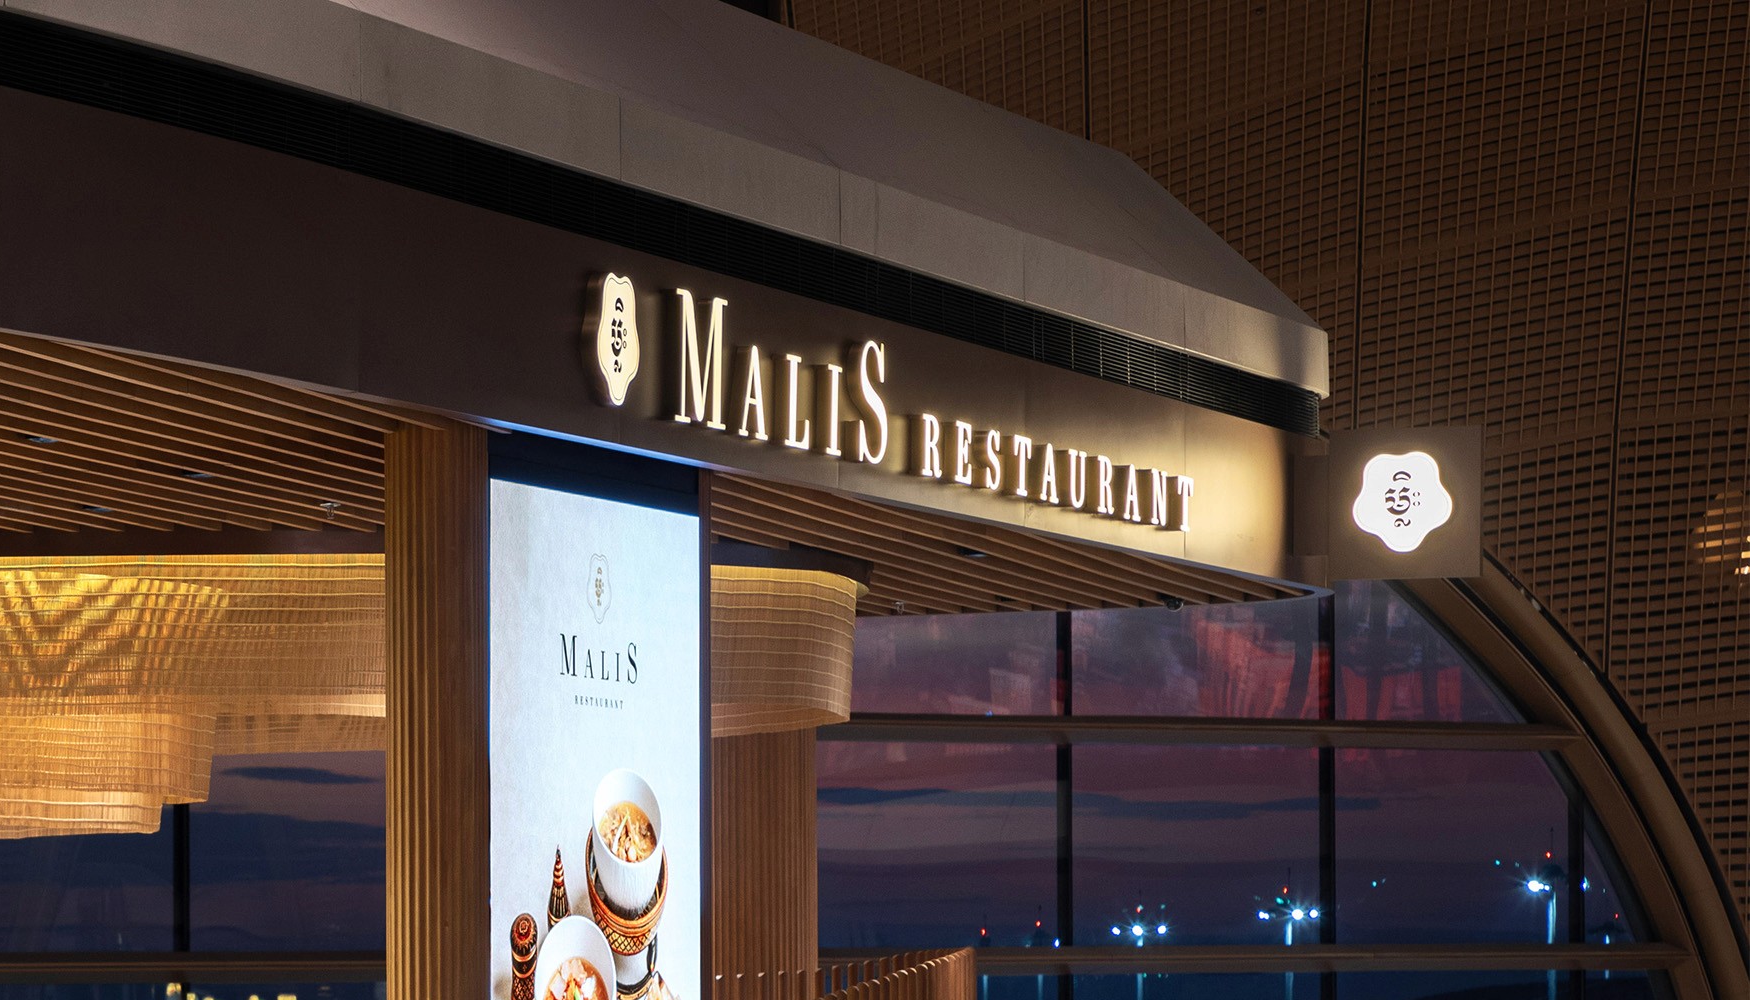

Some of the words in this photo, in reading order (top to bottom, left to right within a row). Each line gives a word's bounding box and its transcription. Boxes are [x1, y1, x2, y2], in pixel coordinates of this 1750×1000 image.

[674, 287, 890, 465] MALIS
[921, 412, 1195, 533] RESTAURANT
[559, 632, 639, 685] MALIS
[574, 694, 624, 710] RESTAURANT
